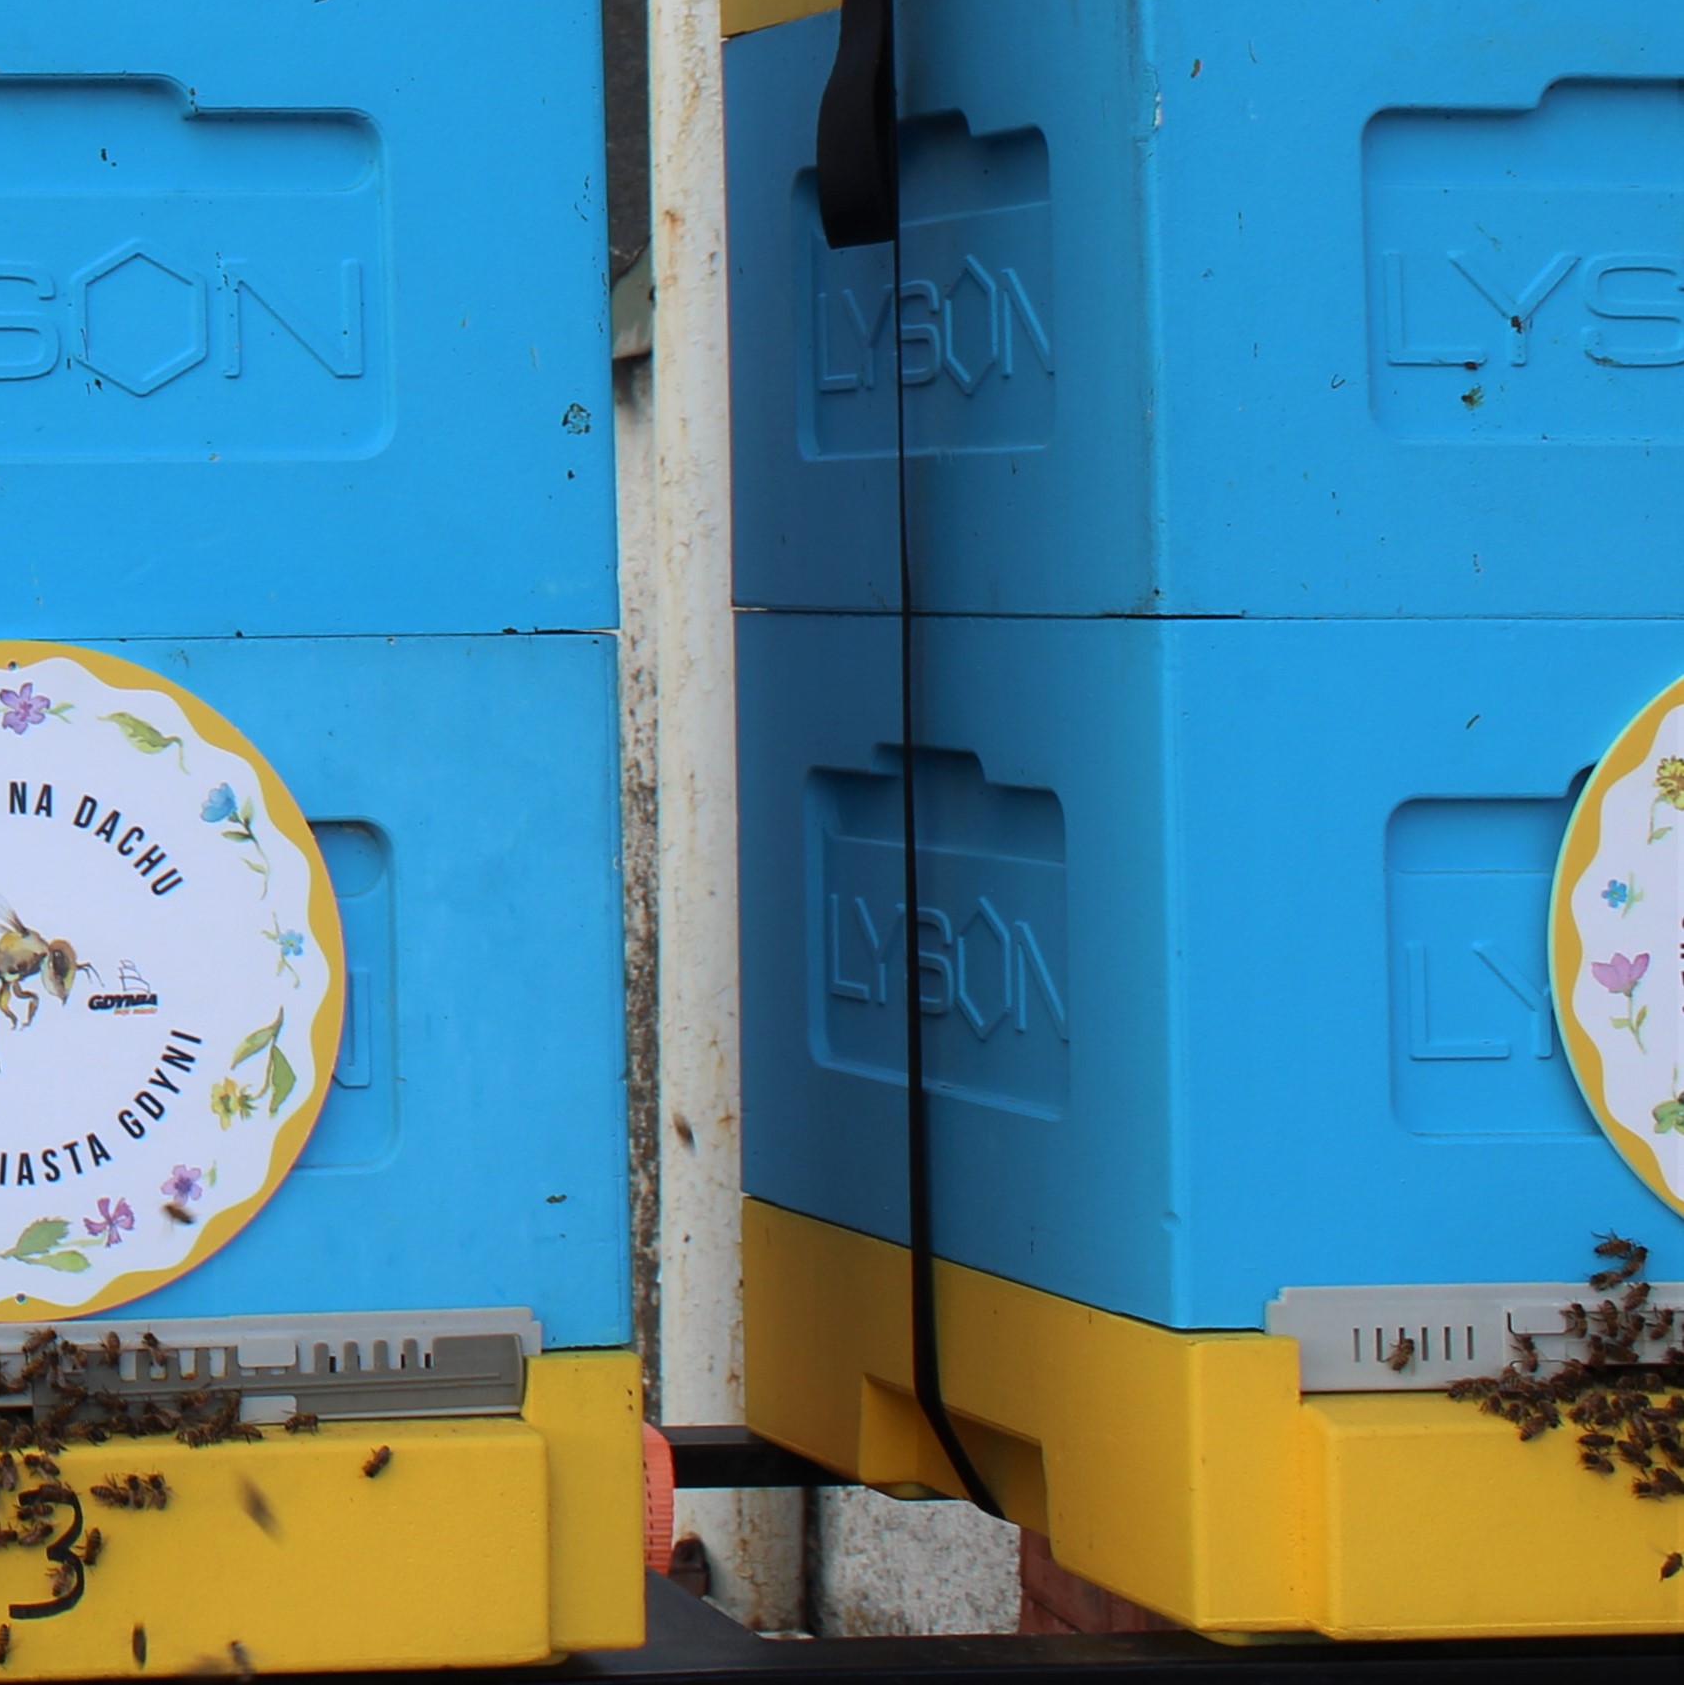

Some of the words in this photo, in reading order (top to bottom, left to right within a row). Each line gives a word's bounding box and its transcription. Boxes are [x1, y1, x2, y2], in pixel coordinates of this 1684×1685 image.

[817, 253, 1055, 397] LYSON
[9, 781, 53, 818] NA
[73, 795, 183, 896] DACHU
[829, 893, 1070, 1043] LYSON
[118, 1030, 202, 1140] GDYNI
[9, 1489, 85, 1620] 3
